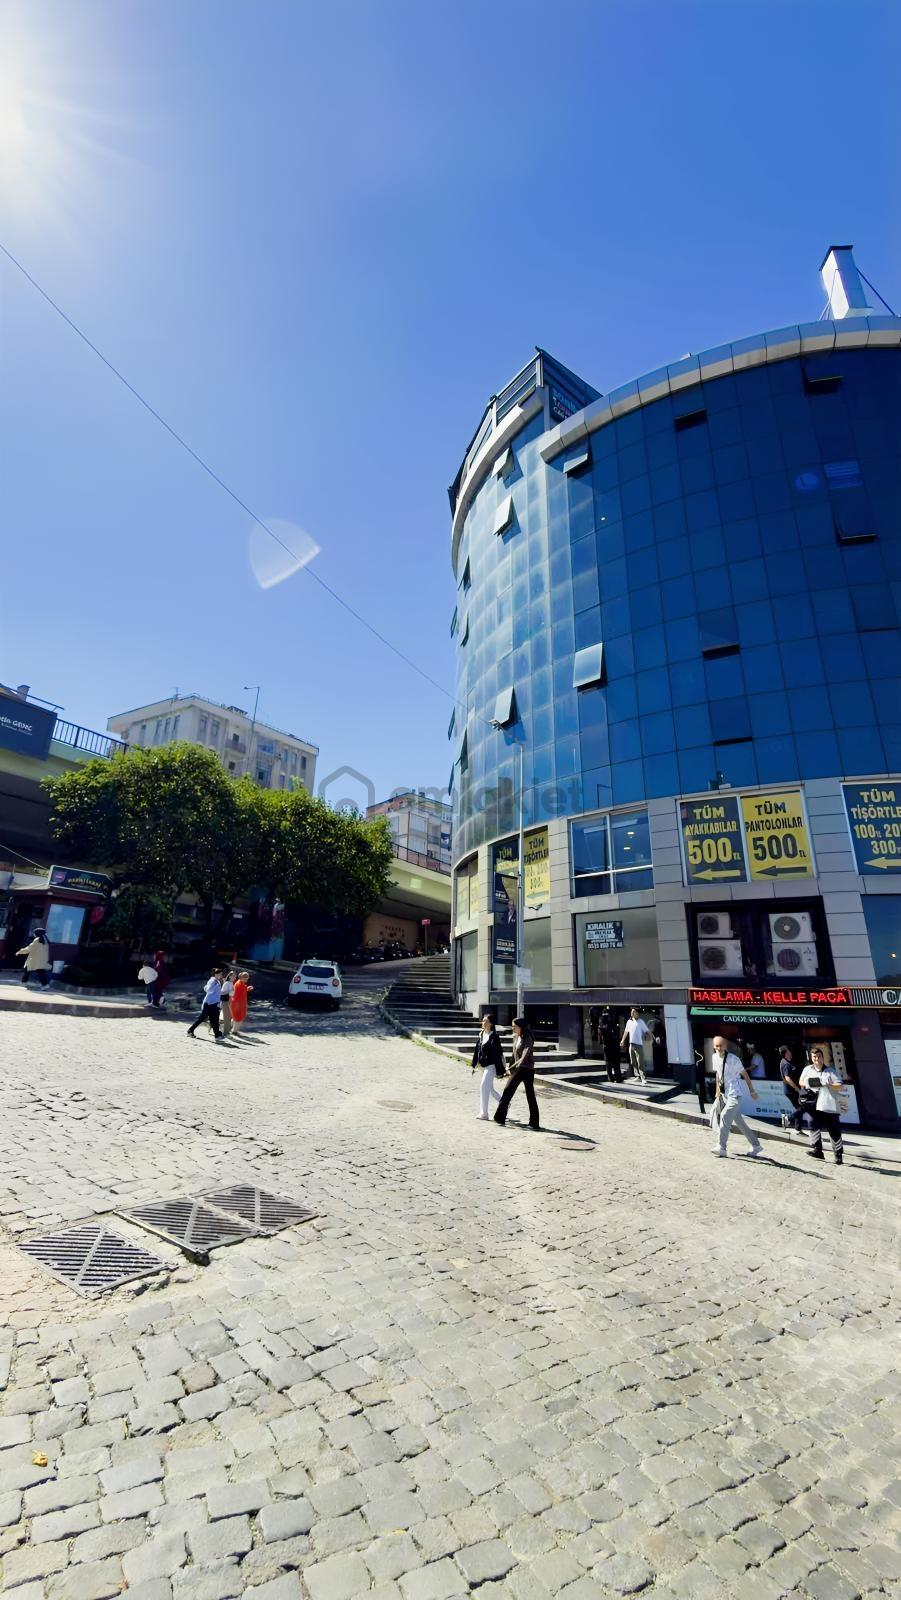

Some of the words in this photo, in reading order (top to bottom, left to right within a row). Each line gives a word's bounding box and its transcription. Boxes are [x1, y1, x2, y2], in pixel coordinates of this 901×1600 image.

[860, 789, 896, 803] TÜM
[693, 804, 725, 819] TÜM
[754, 801, 787, 815] TÜM
[685, 820, 737, 836] AYAKKABILAR
[745, 817, 803, 832] PANTOLONLAR
[529, 837, 545, 850] TÜM
[763, 991, 807, 1002] KELLE
